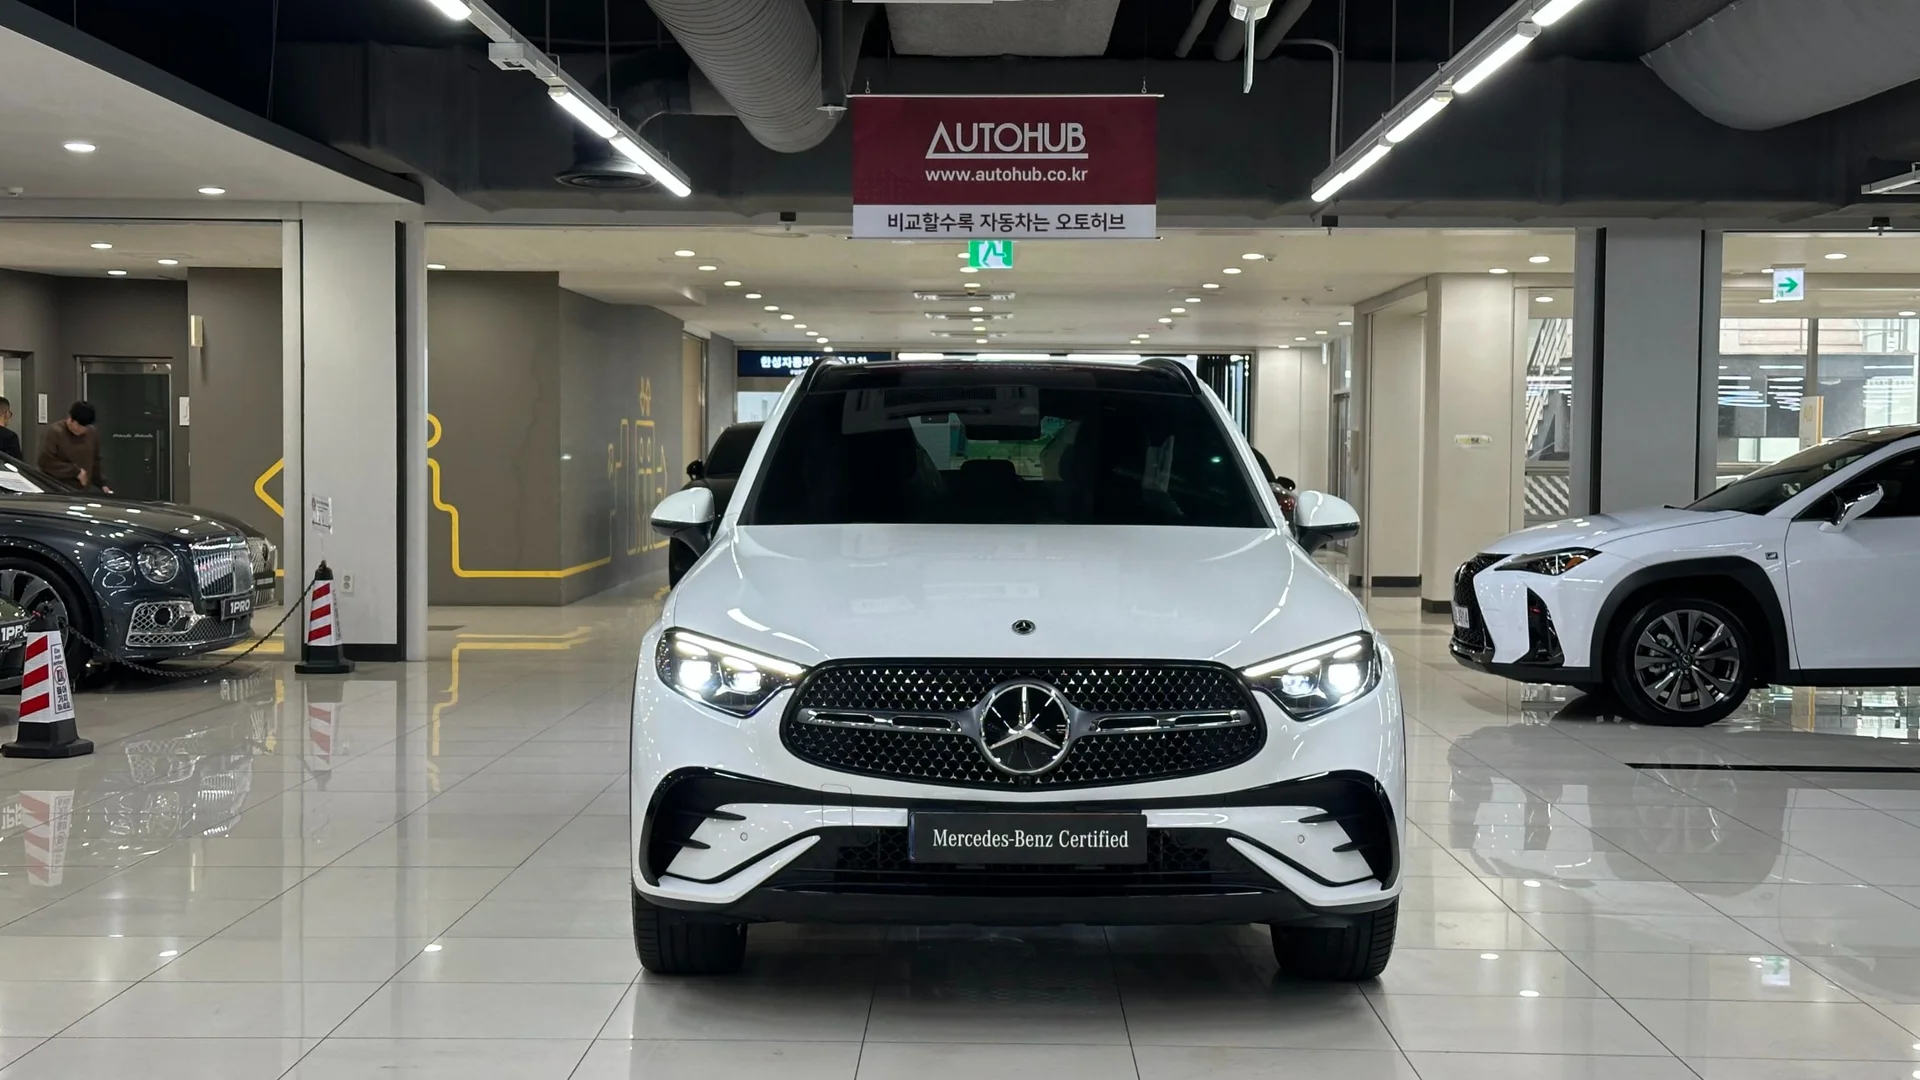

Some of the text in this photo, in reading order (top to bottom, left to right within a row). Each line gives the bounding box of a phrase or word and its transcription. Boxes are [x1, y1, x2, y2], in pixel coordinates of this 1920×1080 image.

[925, 121, 1088, 159] AUTOHUB
[925, 167, 1088, 182] www.autohub.co.kr
[888, 213, 1126, 232] 비교할수록 자동차는 오토허브
[230, 599, 250, 614] 1PRO
[933, 829, 1129, 848] Mercedes-Benz Certified
